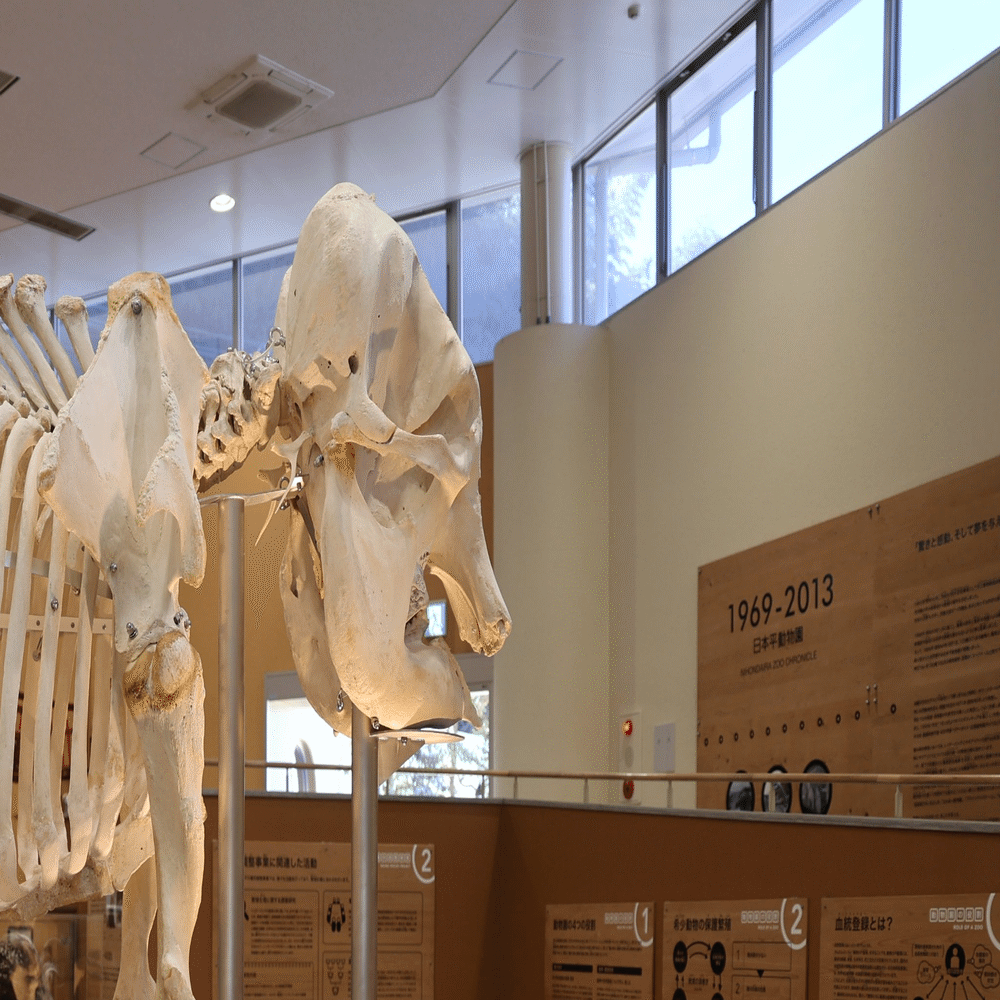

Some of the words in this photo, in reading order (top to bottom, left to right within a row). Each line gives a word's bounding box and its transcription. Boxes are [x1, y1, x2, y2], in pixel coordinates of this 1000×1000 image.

[728, 573, 834, 633] 1969-2013
[753, 626, 803, 654] 日本平動物園
[773, 659, 785, 670] ZOO
[421, 848, 431, 872] 2
[641, 907, 649, 934] 1
[674, 918, 731, 931] 希少動物の保護繁殖
[791, 903, 803, 935] 2
[735, 982, 741, 994] 2
